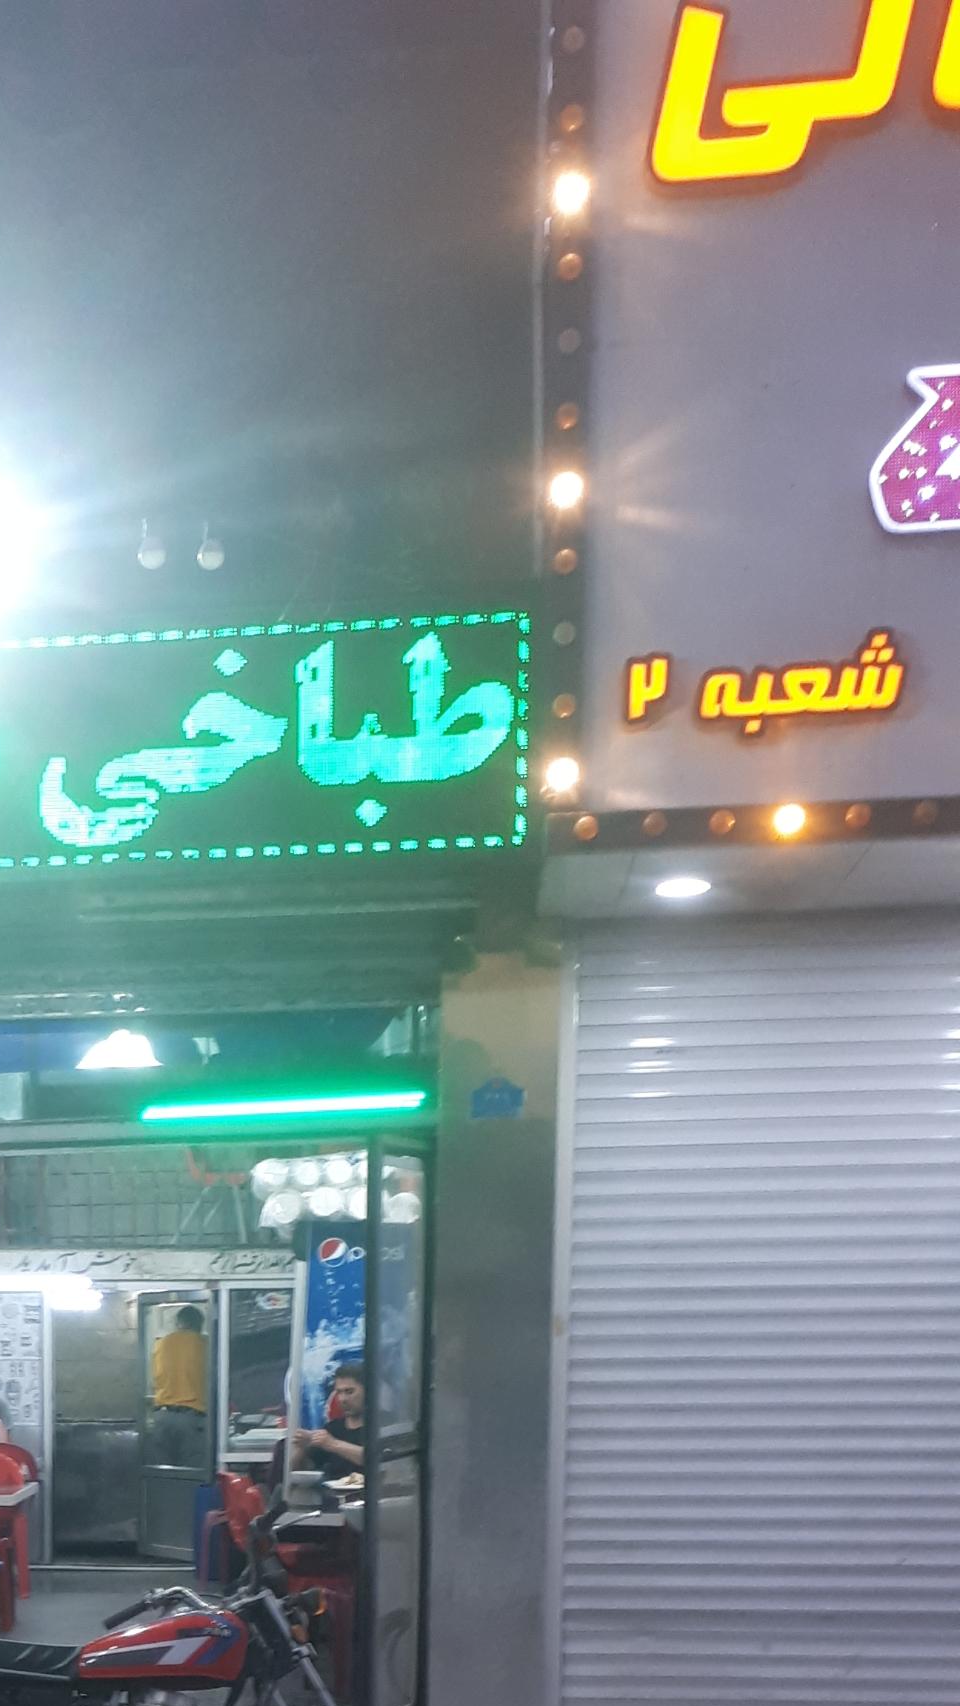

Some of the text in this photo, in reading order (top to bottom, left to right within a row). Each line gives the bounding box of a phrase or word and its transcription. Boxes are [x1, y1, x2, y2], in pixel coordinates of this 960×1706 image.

[40, 632, 515, 848] طباخی
[627, 632, 904, 734] شعبه ۲
